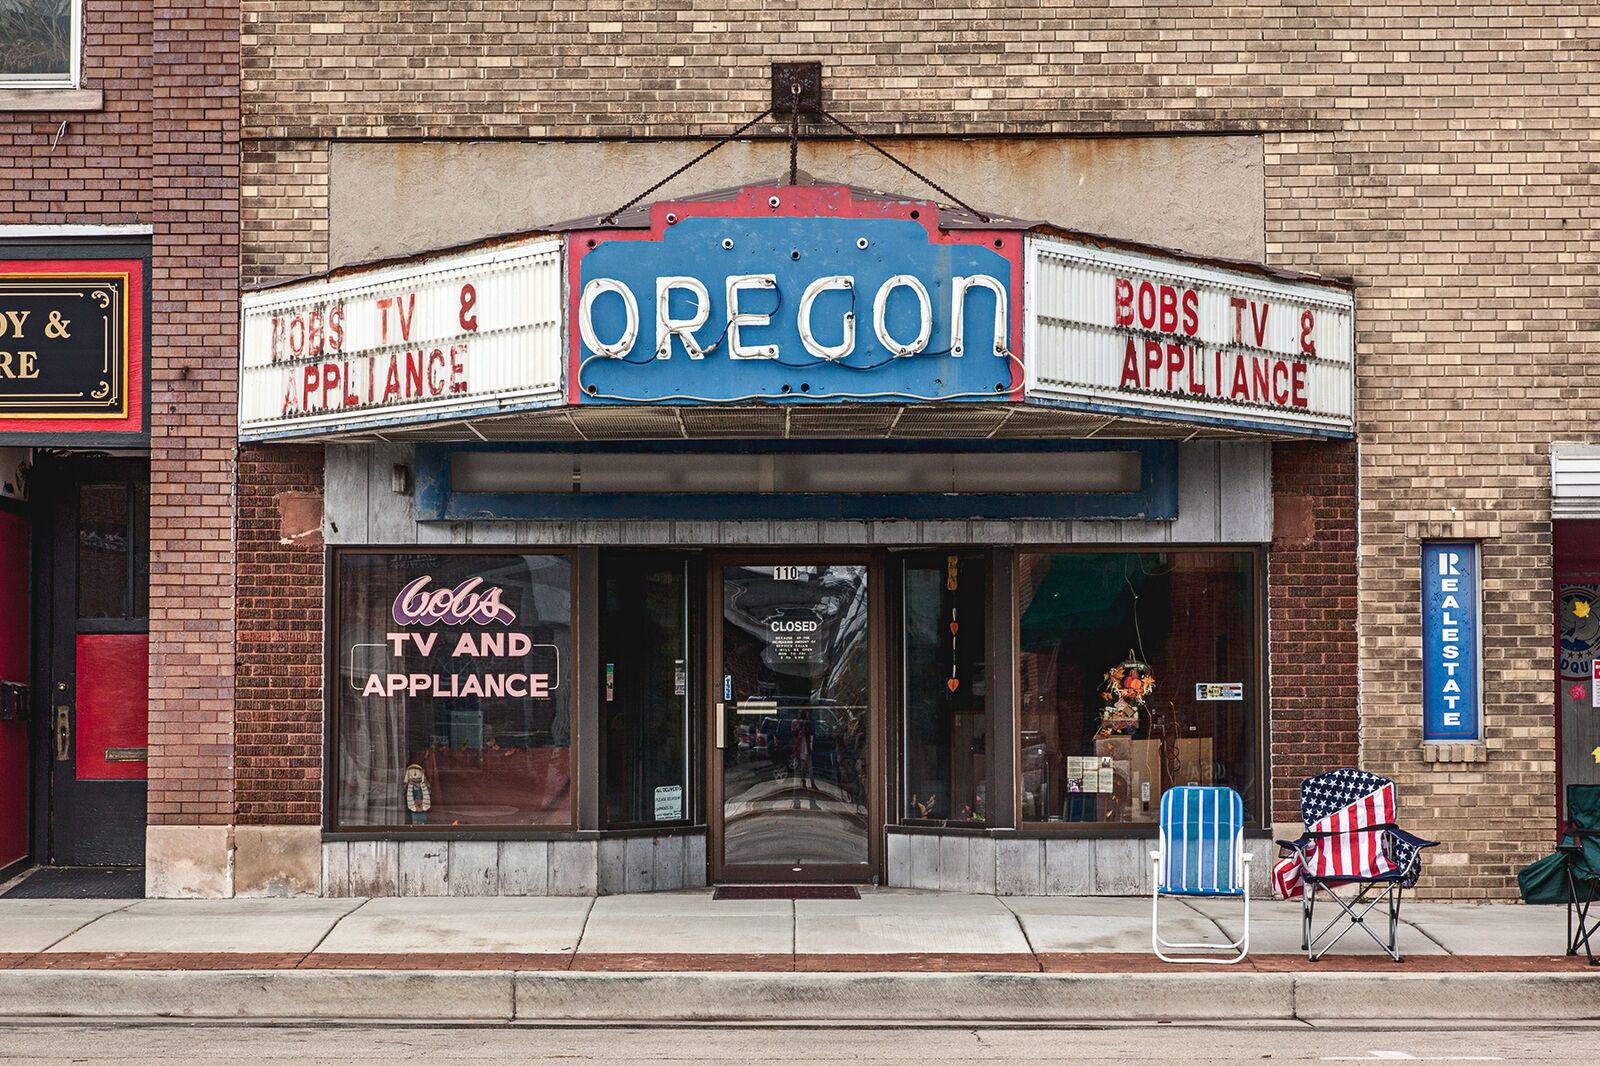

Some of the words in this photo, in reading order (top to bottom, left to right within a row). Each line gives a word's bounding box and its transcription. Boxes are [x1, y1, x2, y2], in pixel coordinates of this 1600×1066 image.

[44, 310, 71, 339] &
[376, 293, 416, 344] TV
[459, 283, 478, 333] &
[579, 274, 1008, 360] OREGON
[1115, 276, 1199, 336] BOBS
[1230, 296, 1269, 347] TV
[1300, 309, 1317, 358] &
[281, 344, 469, 415] APPLIANCE
[1120, 335, 1308, 408] APPLIANCE
[775, 566, 797, 580] 110
[386, 632, 438, 657] TV
[451, 632, 533, 657] AND
[771, 620, 818, 632] CLOSED
[361, 673, 550, 698] APPLIANCE
